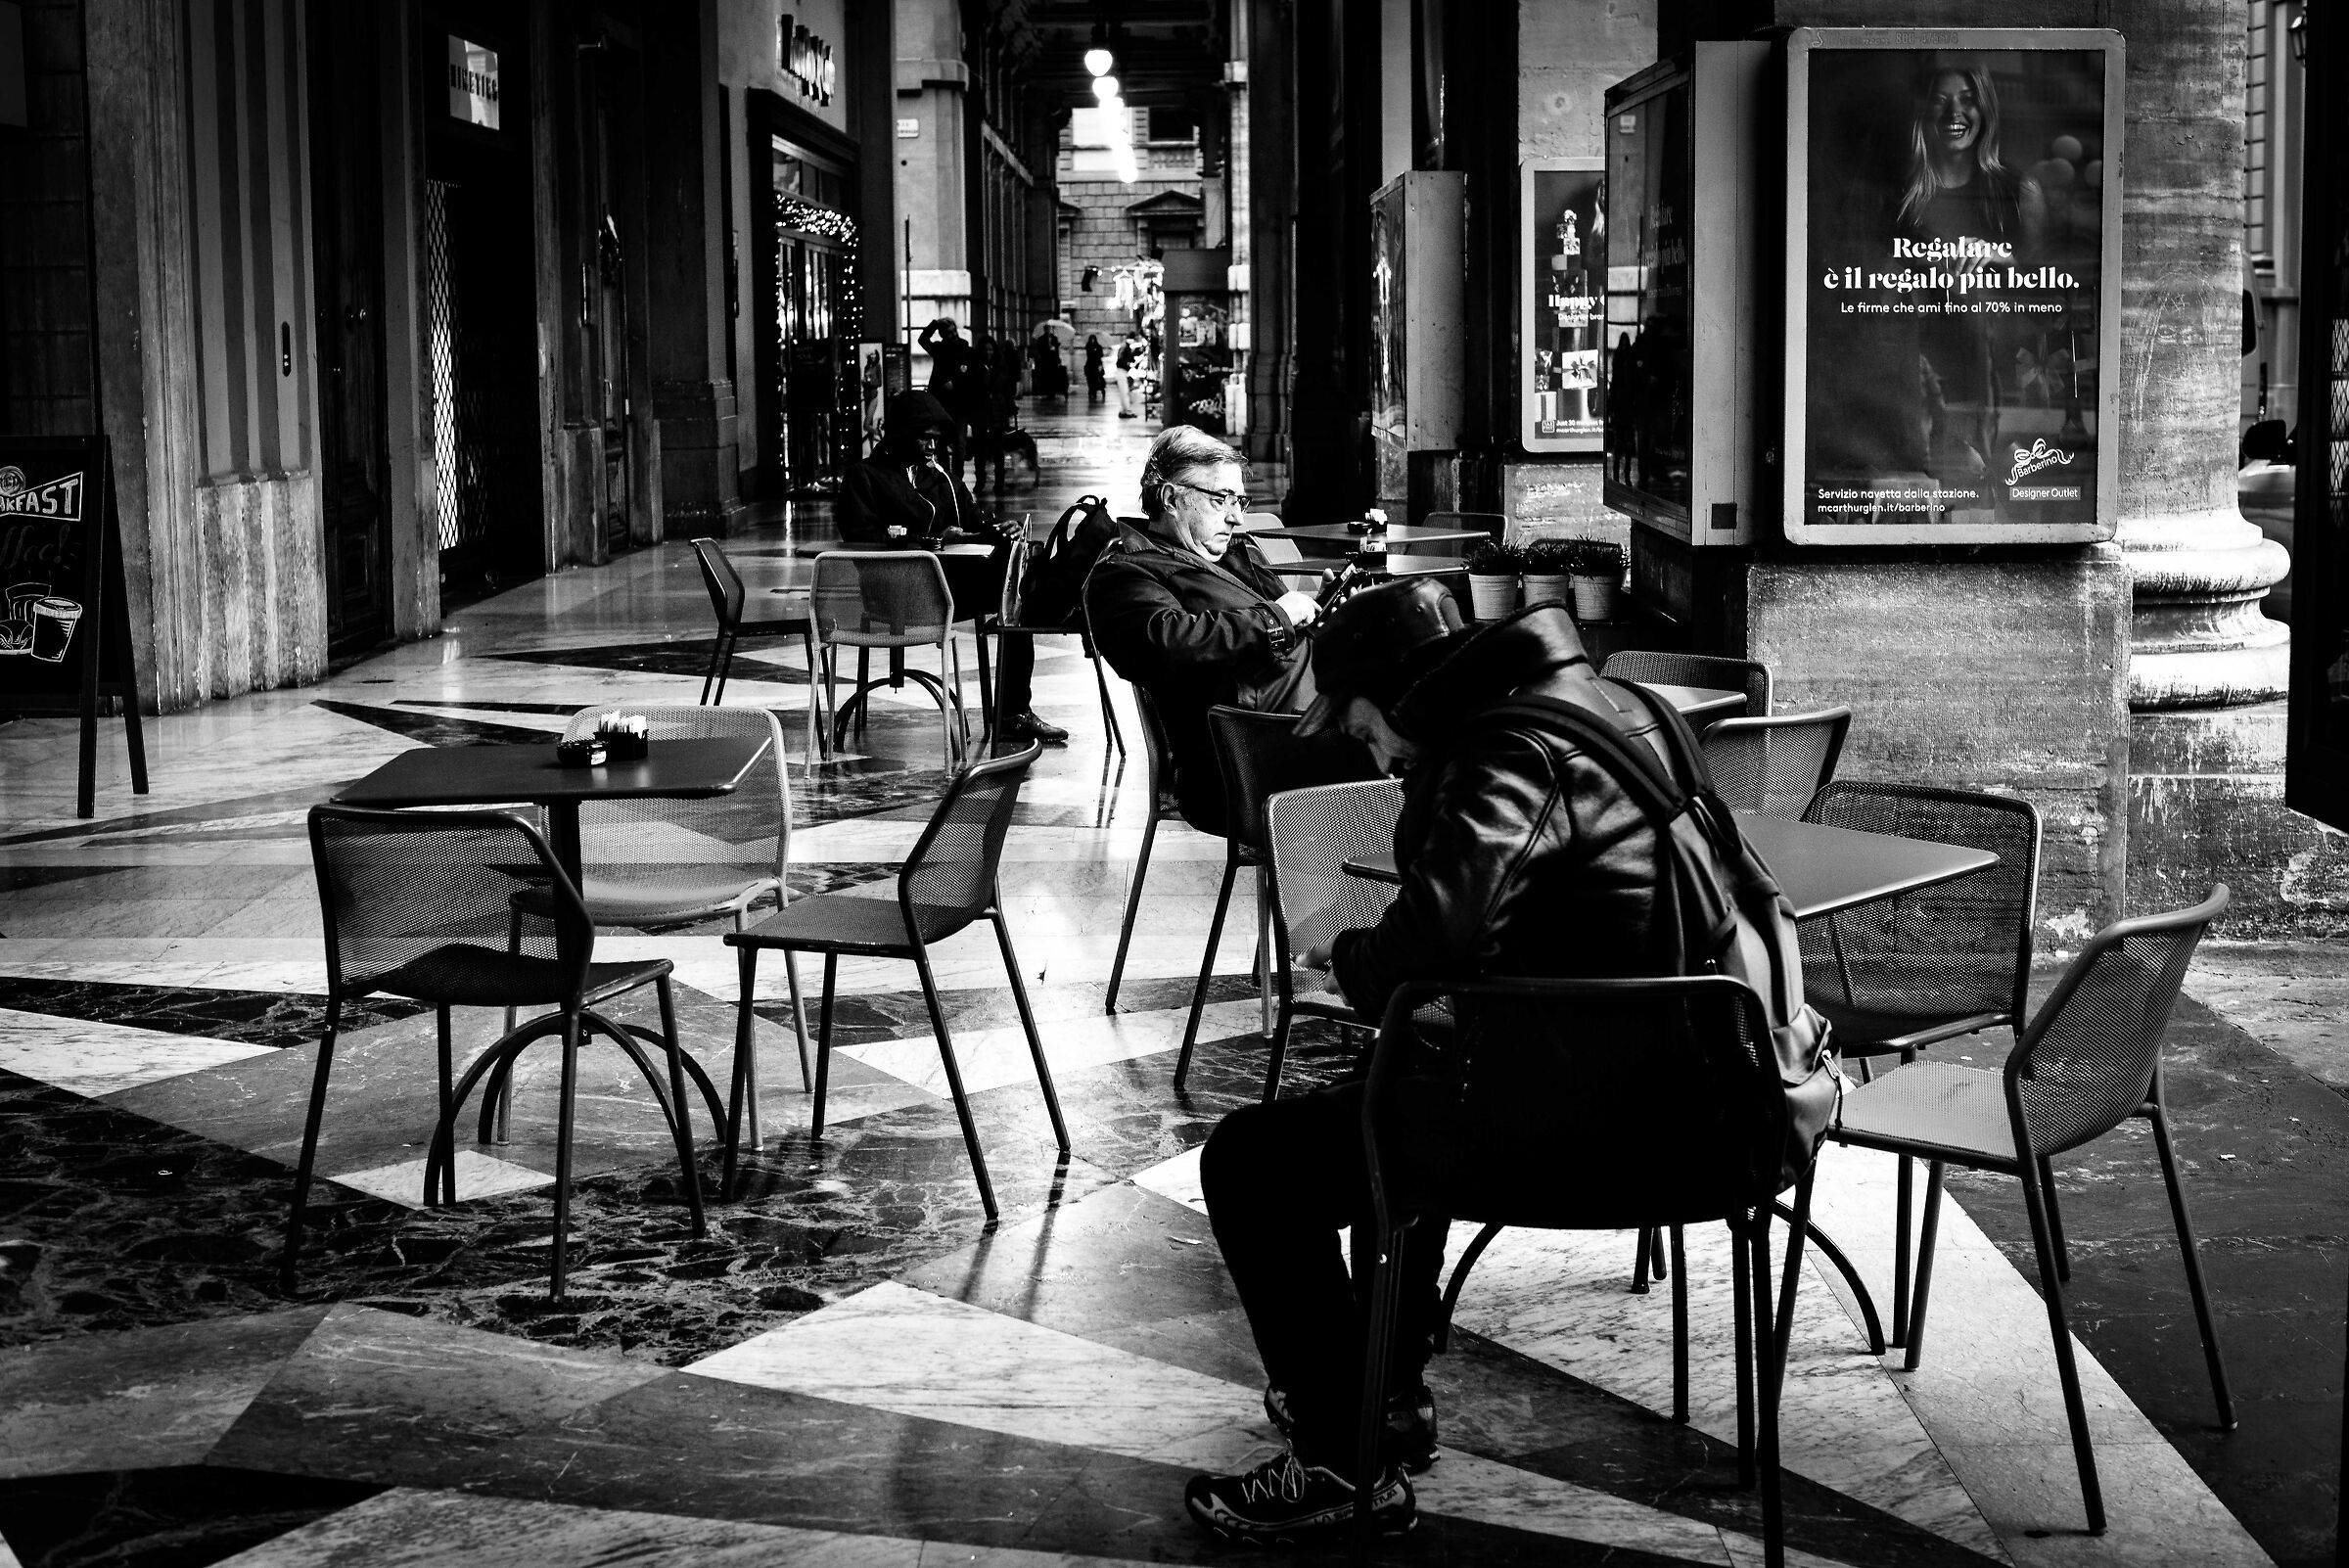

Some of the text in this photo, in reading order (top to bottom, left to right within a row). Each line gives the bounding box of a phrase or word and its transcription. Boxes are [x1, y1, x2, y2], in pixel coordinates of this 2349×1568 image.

[450, 65, 497, 102] NINETIES
[1893, 236, 2012, 262] Regalare
[1823, 266, 2080, 294] è il regalo più bello.
[1548, 295, 1597, 310] Happy
[1841, 301, 2062, 314] Le firme che ami fino al 70% in meno
[2016, 456, 2057, 478] Barberino
[1818, 488, 1979, 499] Servizio navetta dalla stazione.
[2012, 487, 2078, 500] Designer Outlet
[1818, 502, 1946, 515] mcarthurglen.it/barberino
